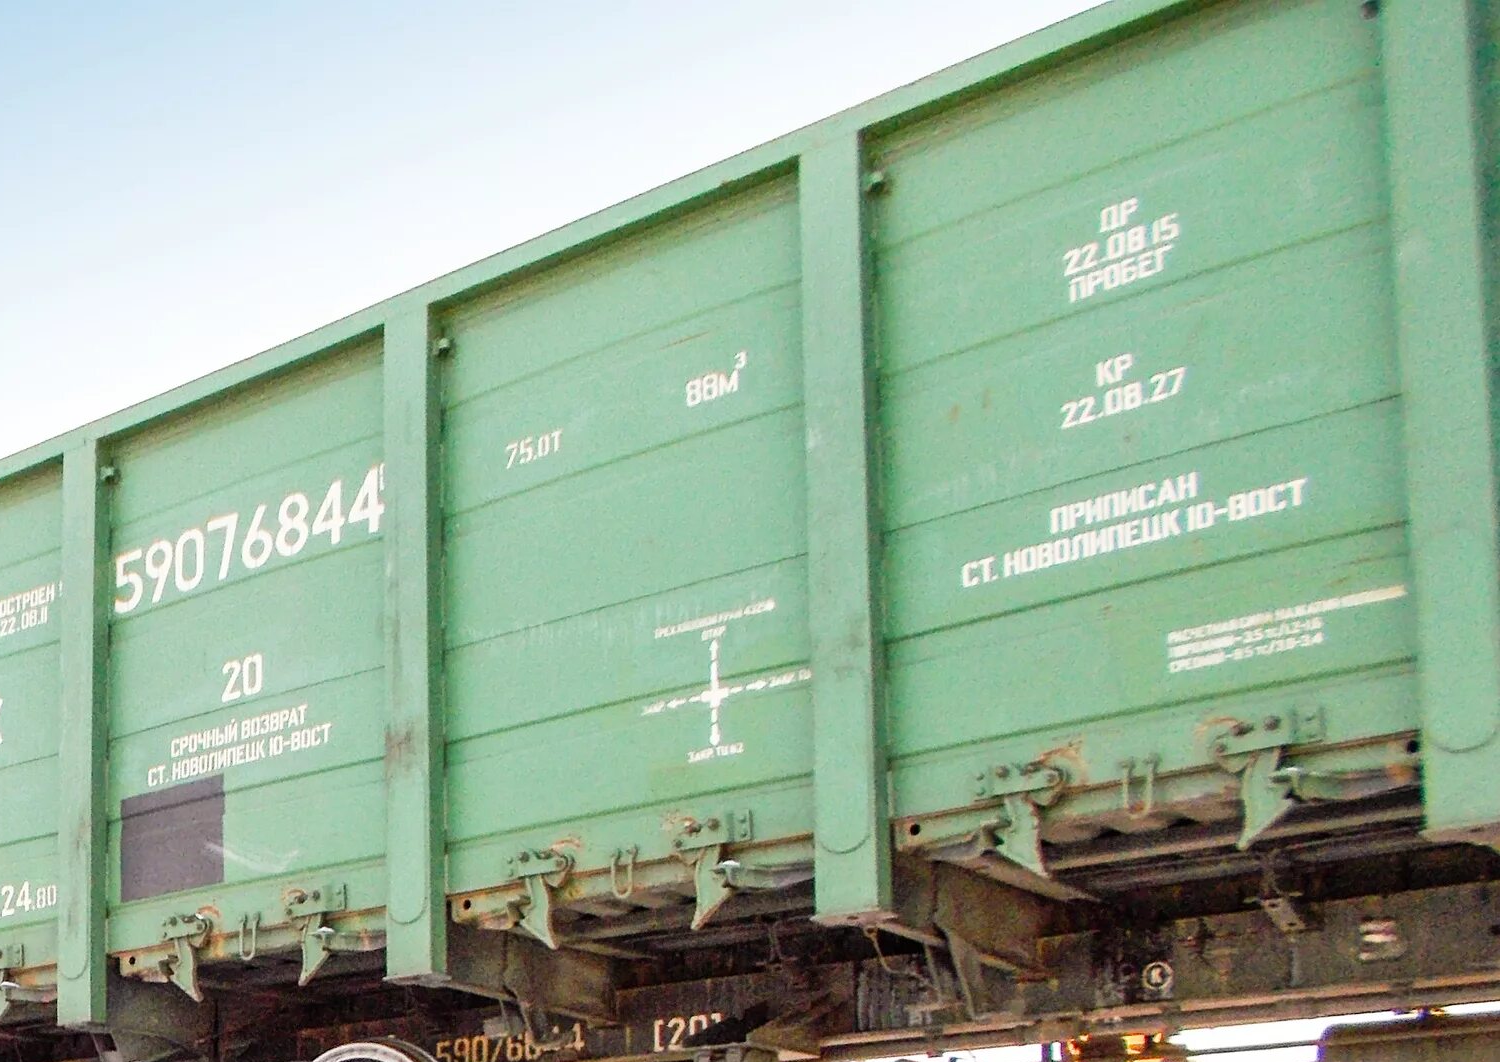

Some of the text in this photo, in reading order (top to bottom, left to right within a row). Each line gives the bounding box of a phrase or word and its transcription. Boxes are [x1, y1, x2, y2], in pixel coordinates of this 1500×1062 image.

[1069, 243, 1174, 304] ПРОБЕГ
[1096, 353, 1133, 387] КР
[1050, 471, 1199, 534] ПРИПИСАН
[114, 463, 385, 615] 59076844
[1003, 509, 1181, 578] НОВОЛИПЕЦК
[221, 653, 263, 703] 20
[171, 704, 308, 758] СРОЧНЫЙ ВОЗВРАТ
[172, 740, 265, 781] НОВОЛИПЕЦК
